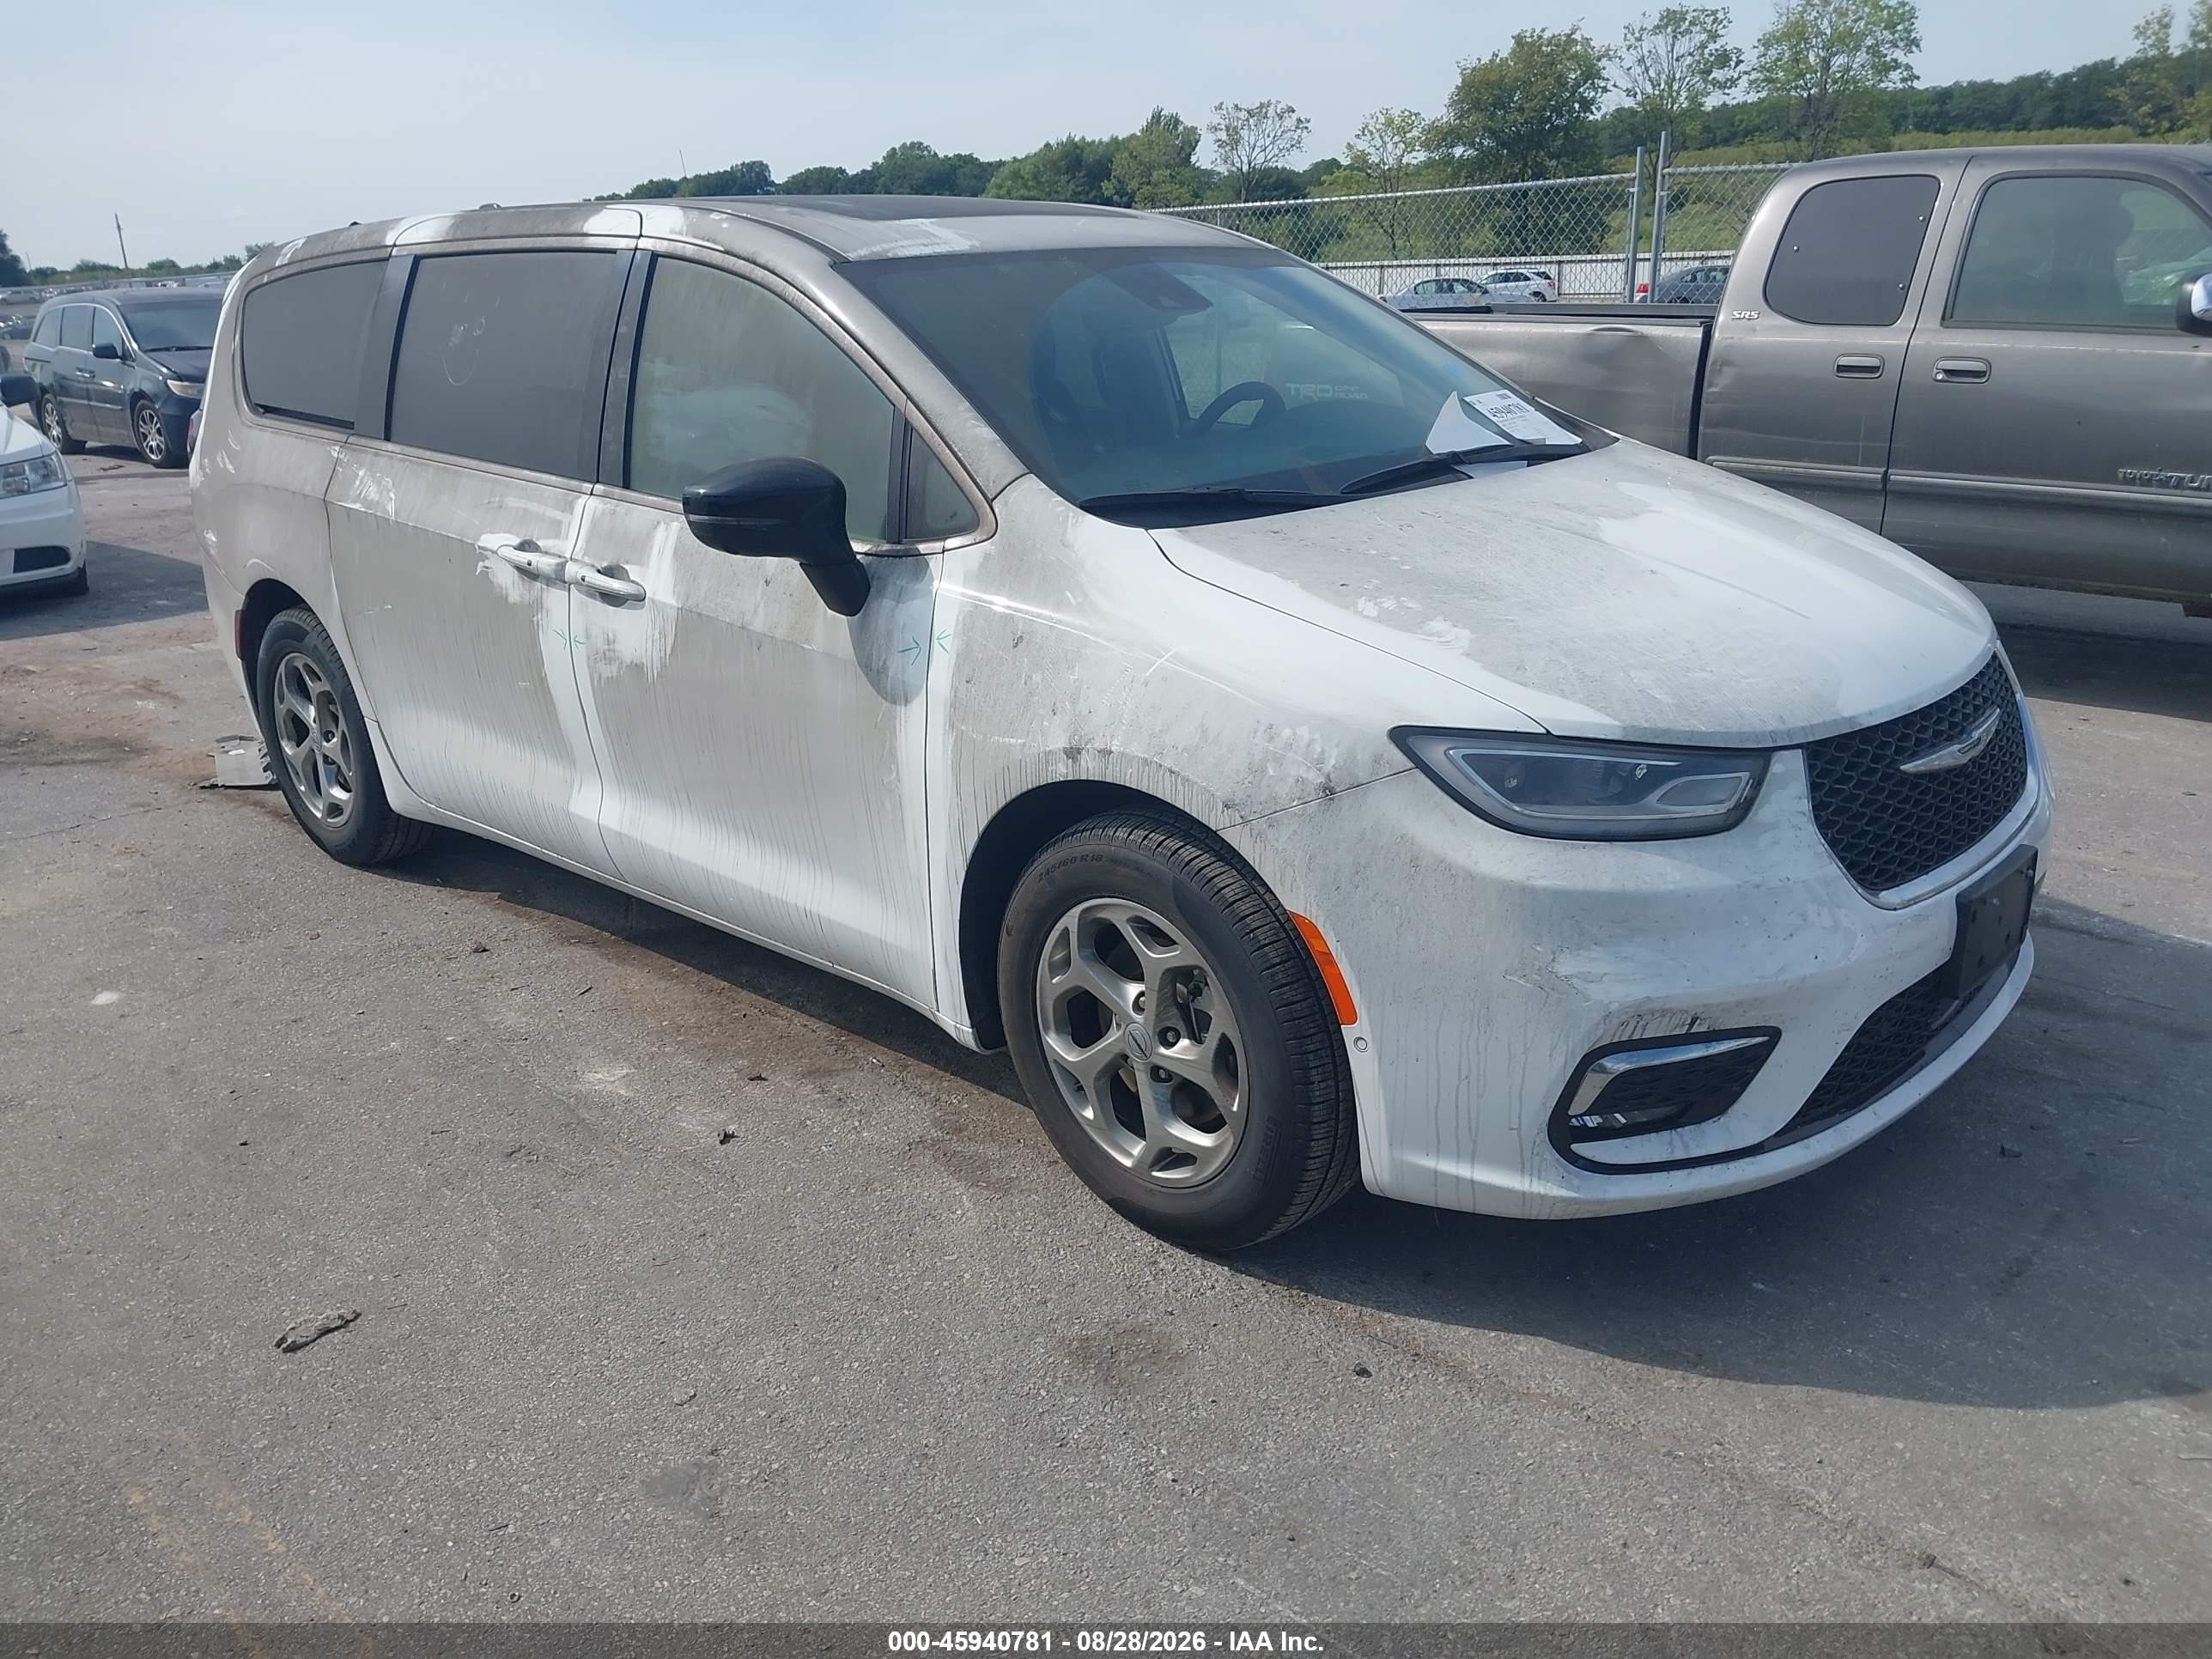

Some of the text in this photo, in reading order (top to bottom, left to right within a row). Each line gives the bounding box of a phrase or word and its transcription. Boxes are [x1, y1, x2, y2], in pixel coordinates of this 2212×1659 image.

[1730, 310, 1760, 320] SR5
[1285, 383, 1334, 401] TRD
[2118, 467, 2169, 482] TOYOTA
